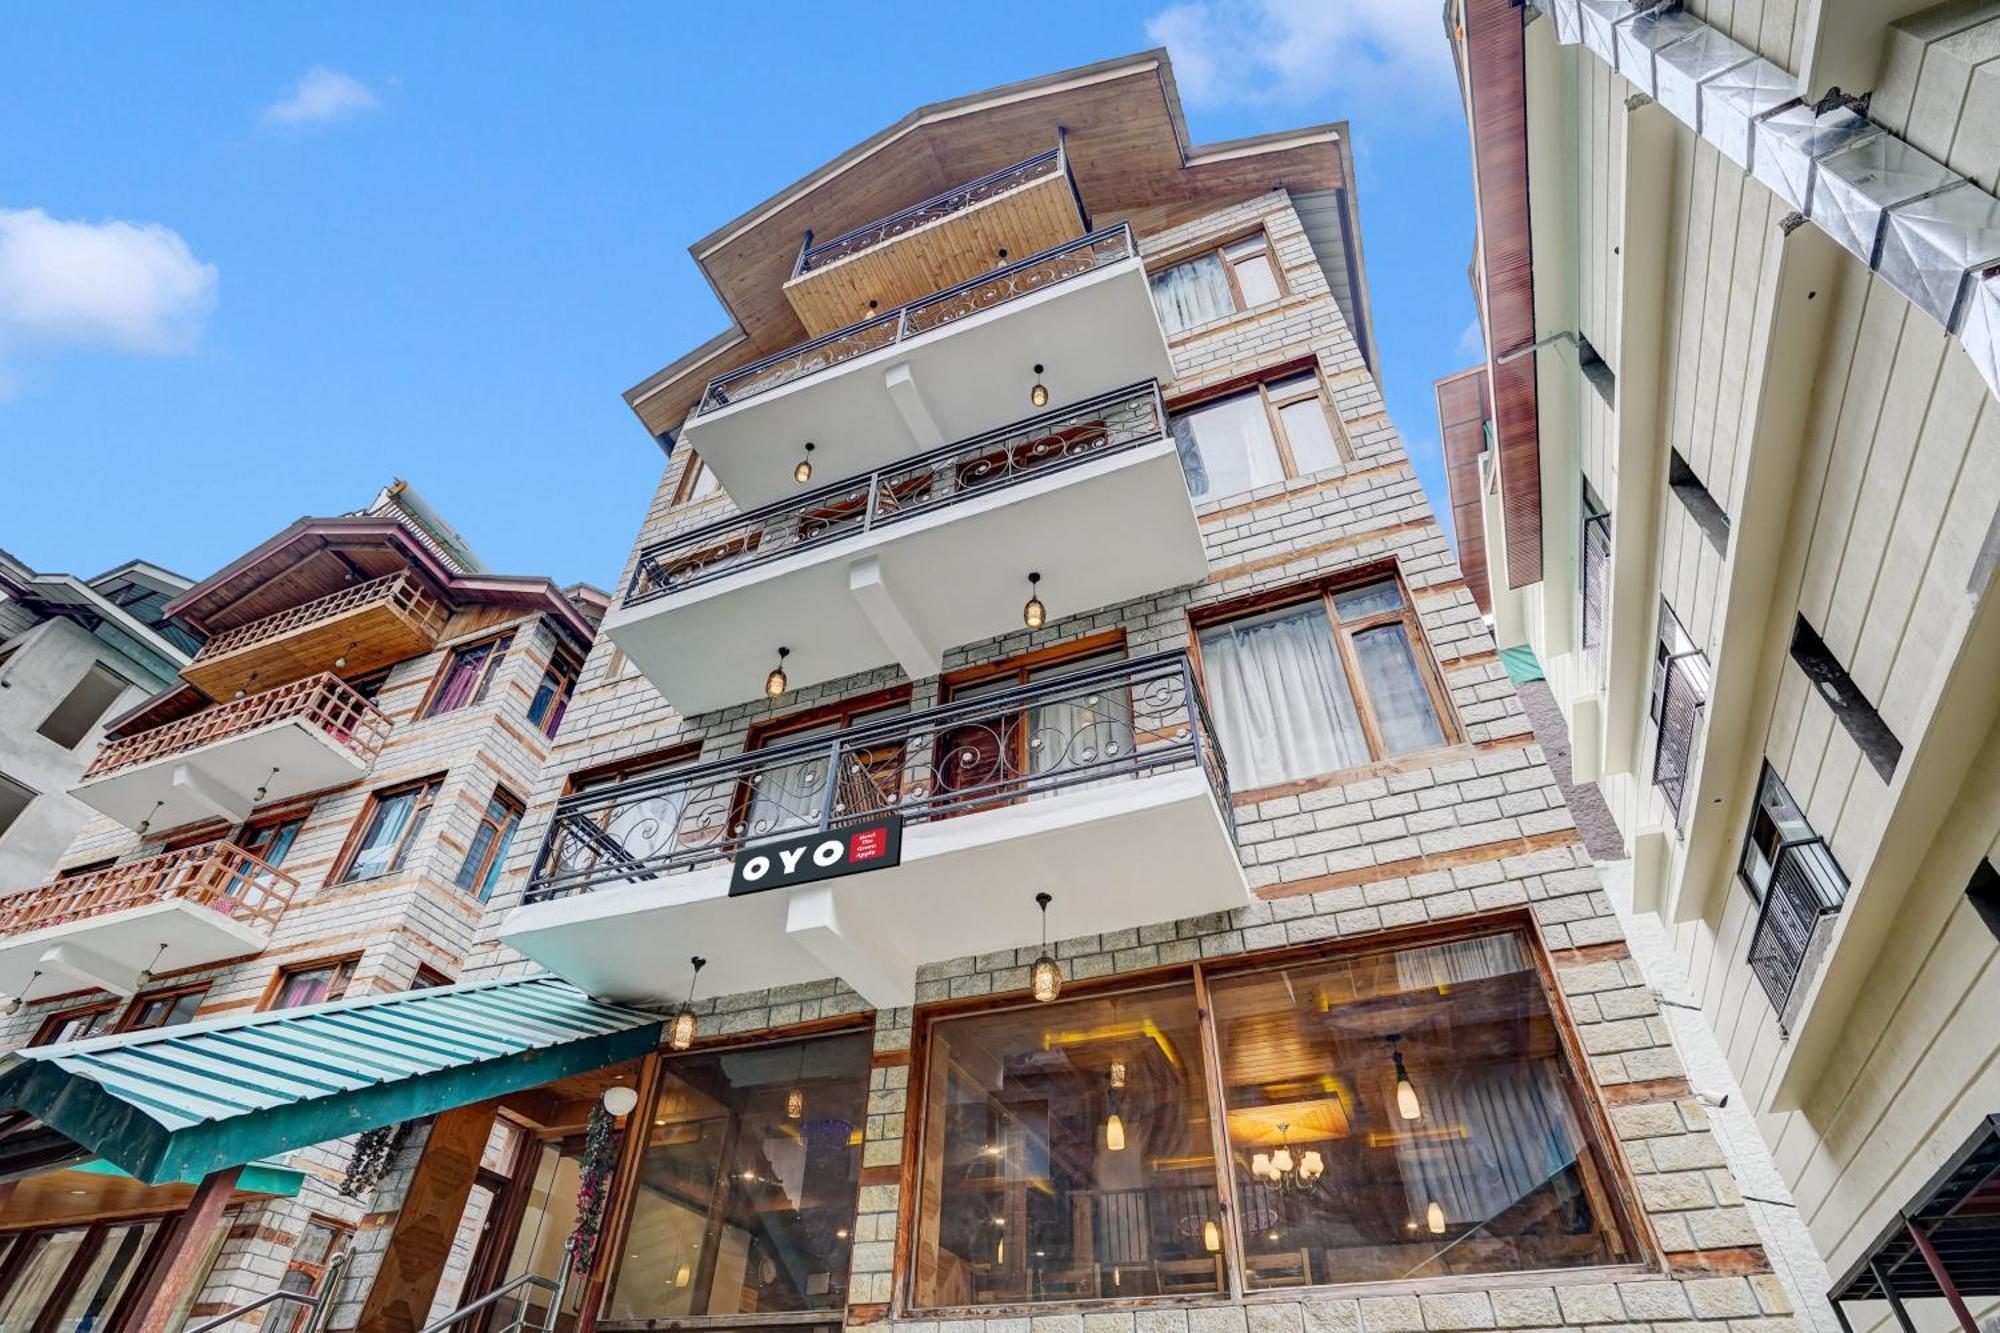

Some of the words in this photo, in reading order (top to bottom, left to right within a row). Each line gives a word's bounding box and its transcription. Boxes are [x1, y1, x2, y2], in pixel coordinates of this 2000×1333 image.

[859, 832, 876, 840] Hotel
[856, 850, 876, 859] Apple
[742, 840, 844, 881] OYO
